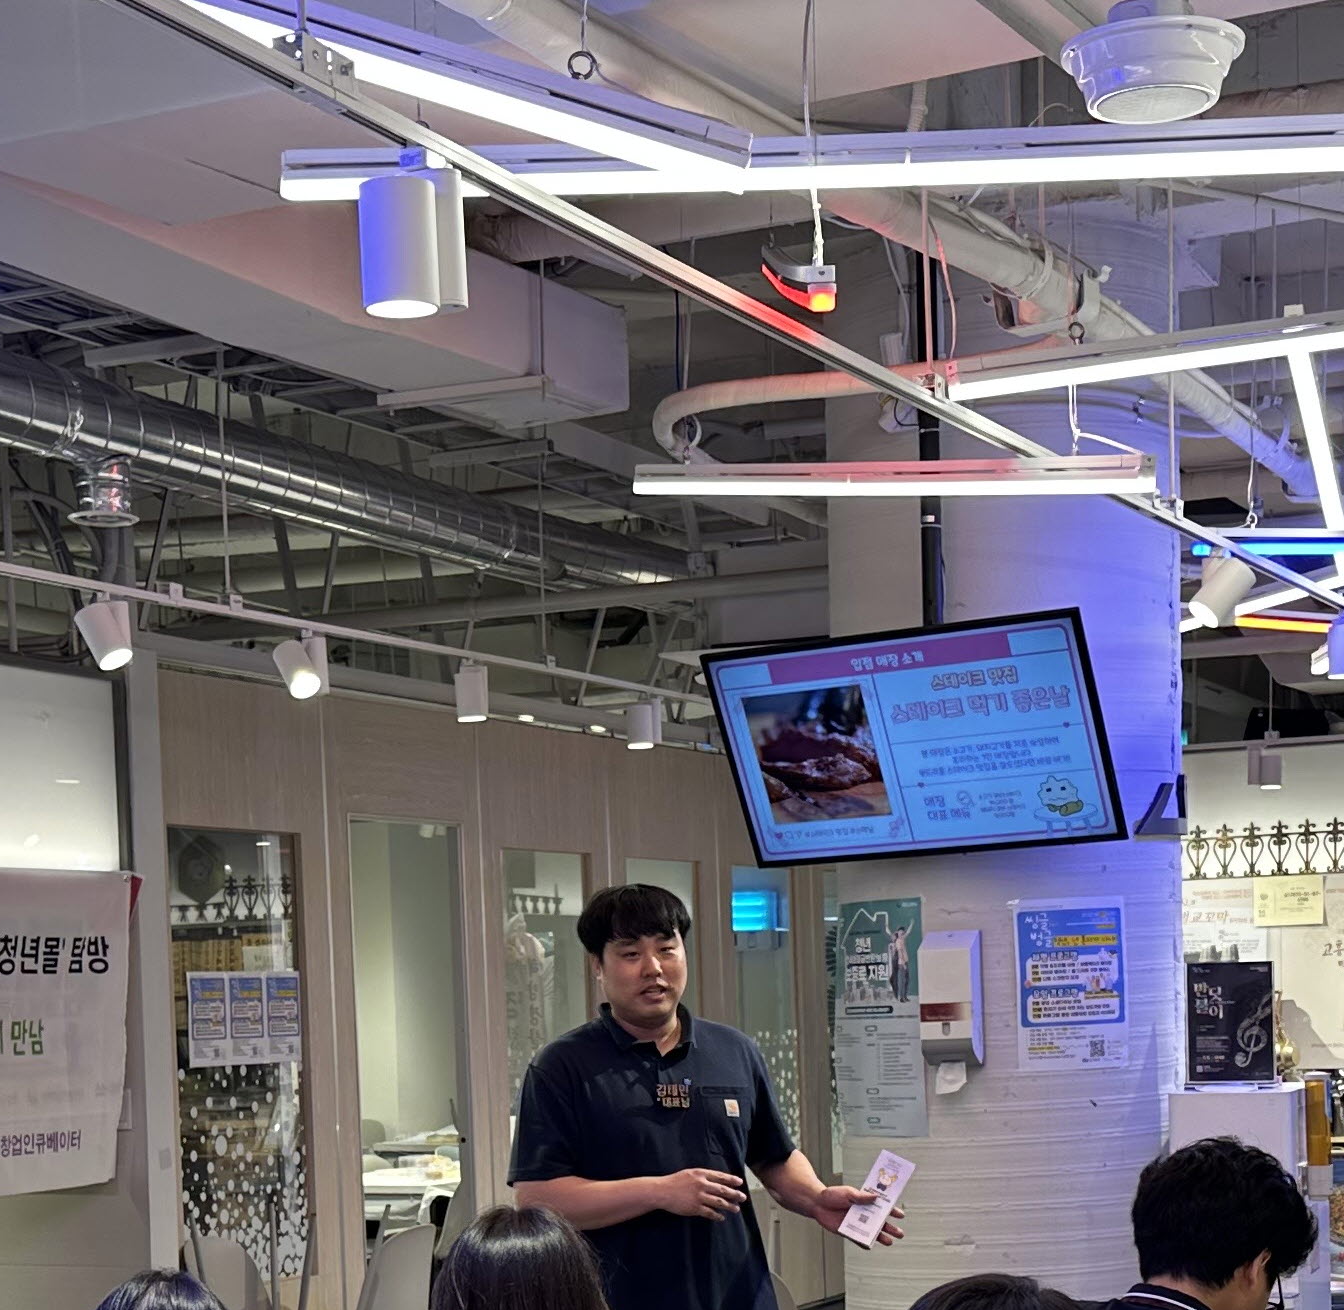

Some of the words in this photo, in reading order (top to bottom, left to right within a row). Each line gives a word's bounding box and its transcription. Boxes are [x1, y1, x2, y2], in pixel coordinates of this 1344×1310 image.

[931, 669, 986, 691] 스테이크
[988, 665, 1019, 686] 맛집
[891, 696, 965, 724] 스테이크
[969, 692, 1009, 716] 먹기
[70, 935, 110, 975] 탐방
[868, 964, 889, 981] 지원
[10, 1020, 45, 1056] 만남
[0, 1129, 82, 1158] 창업인큐베이터
